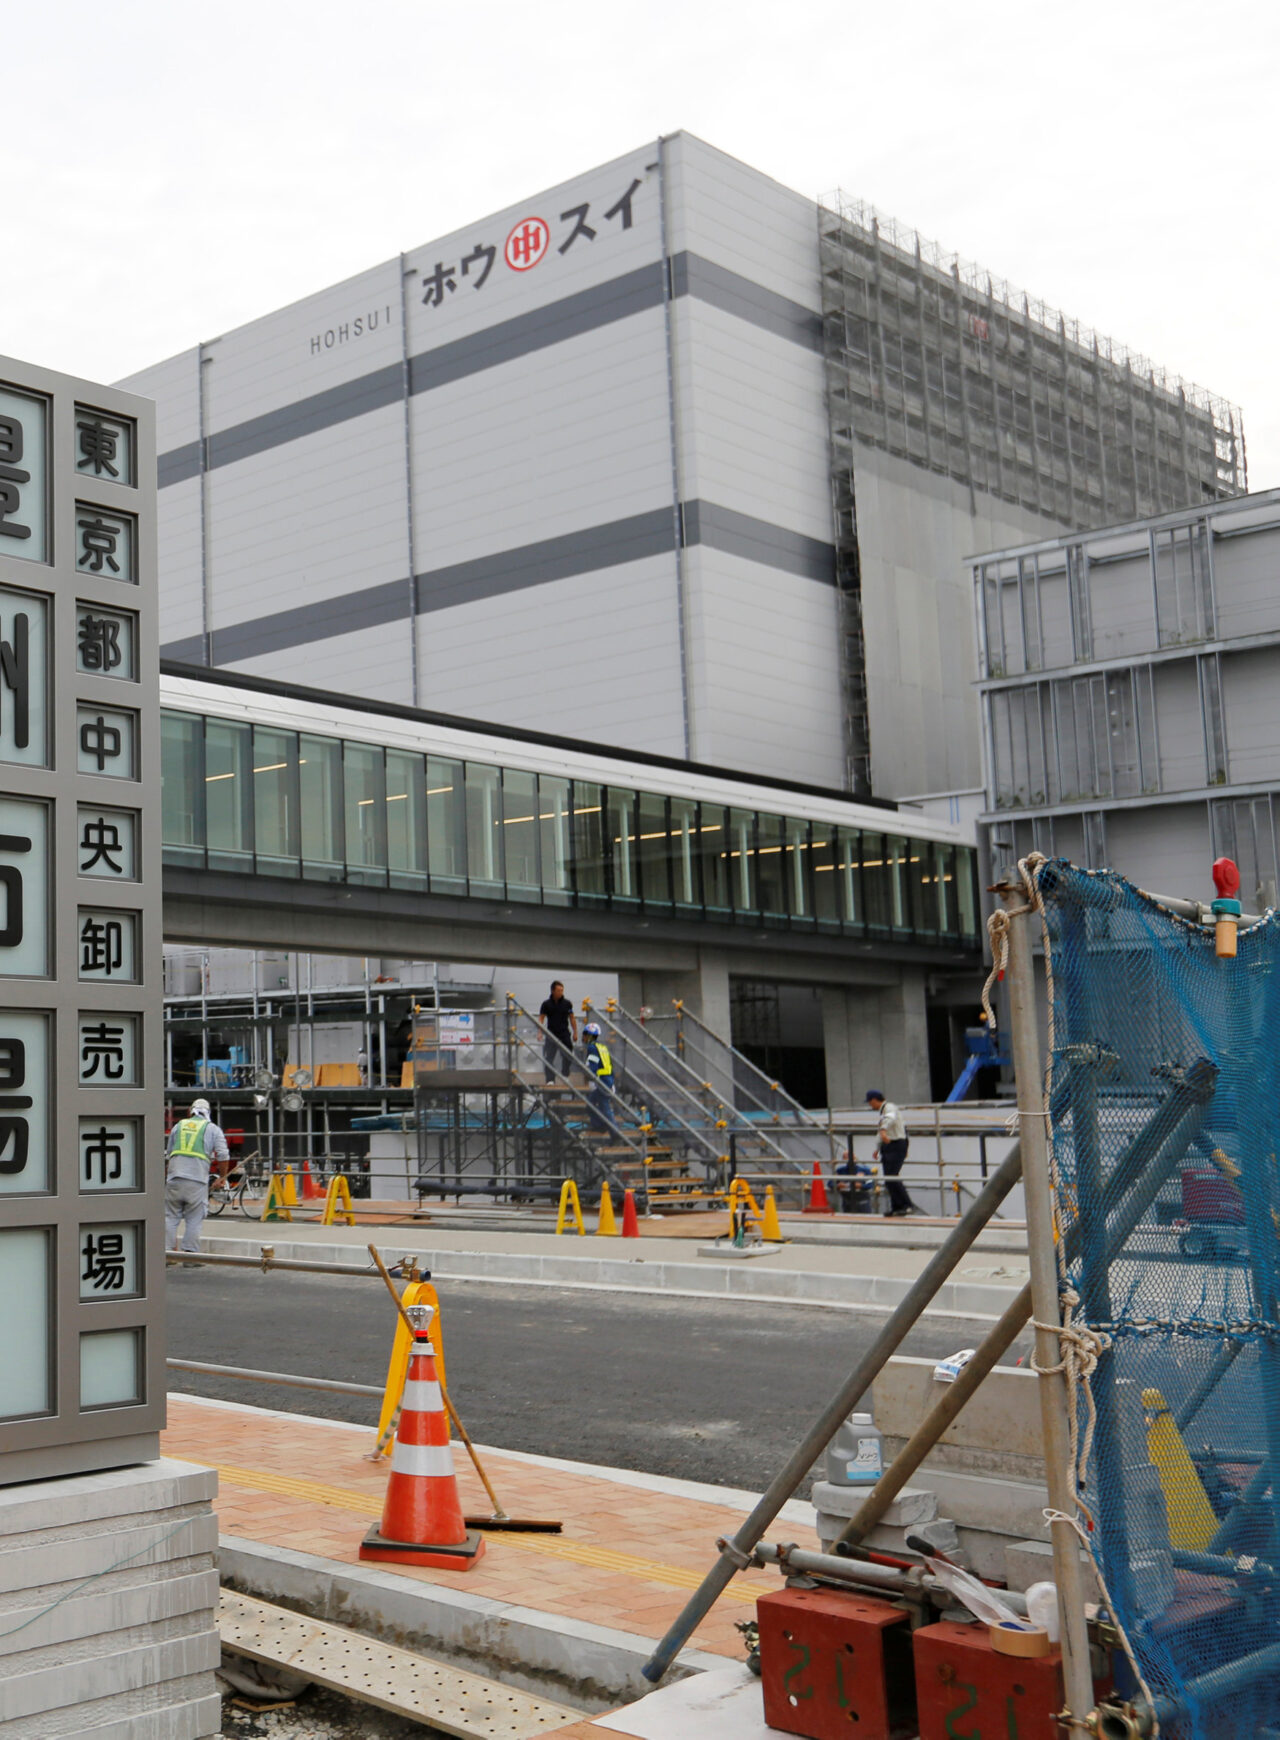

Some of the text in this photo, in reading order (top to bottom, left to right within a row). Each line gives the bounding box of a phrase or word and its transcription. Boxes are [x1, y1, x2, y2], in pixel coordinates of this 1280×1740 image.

[310, 305, 392, 355] HOHSUI
[76, 420, 126, 1290] 東京都中央卸売市場
